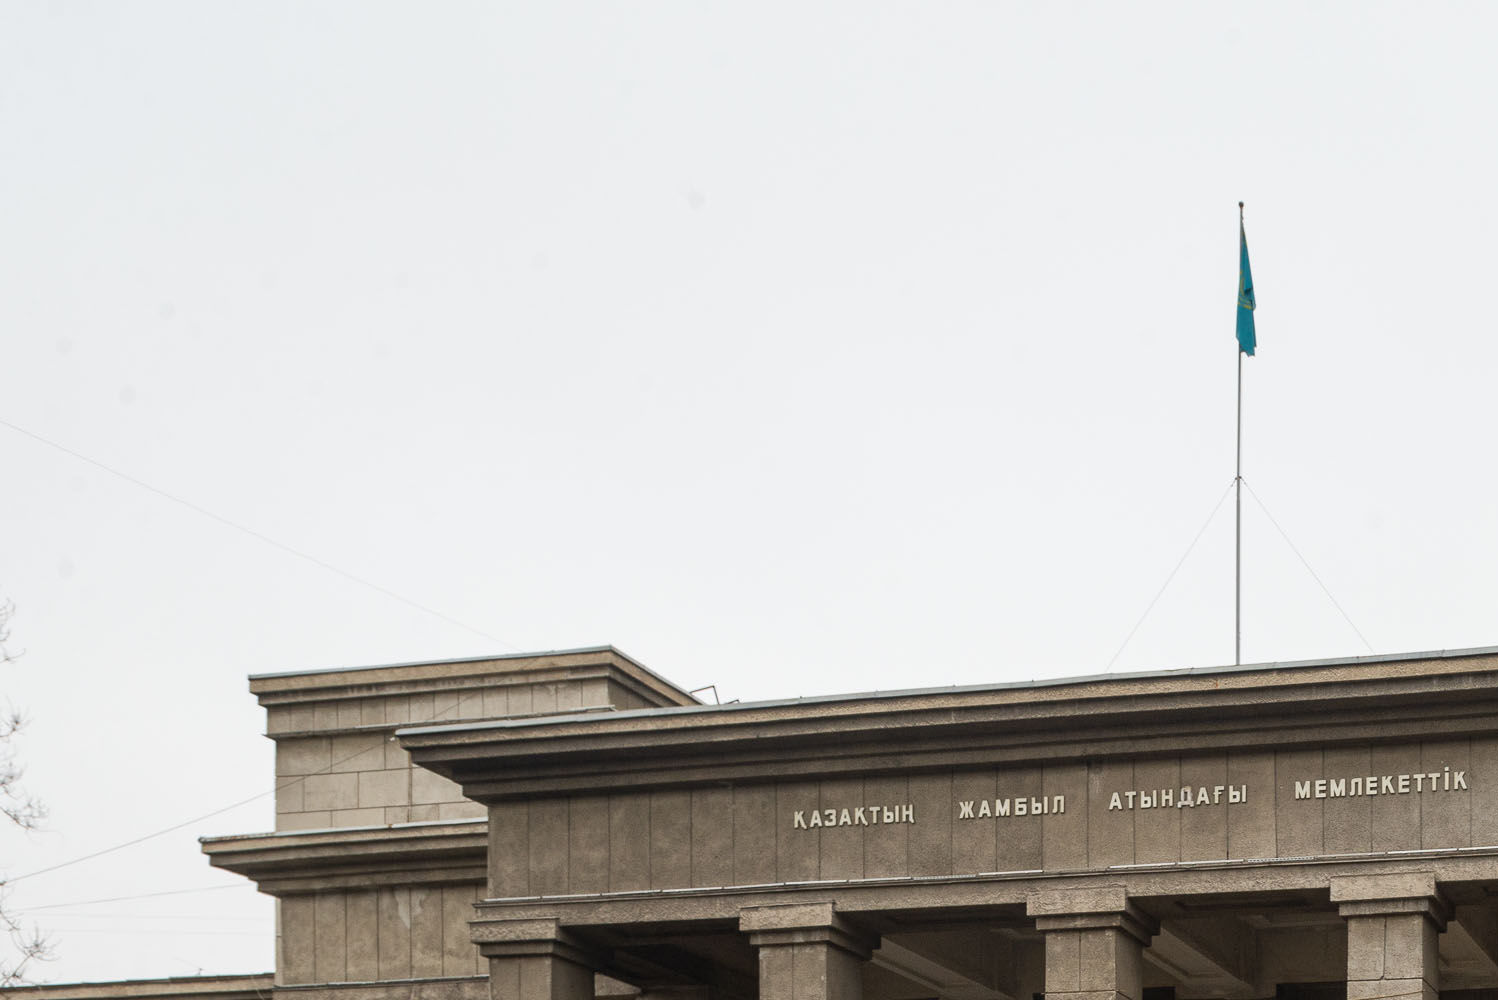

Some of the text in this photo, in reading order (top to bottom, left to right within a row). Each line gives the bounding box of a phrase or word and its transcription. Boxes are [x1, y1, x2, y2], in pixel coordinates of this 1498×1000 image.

[793, 804, 915, 830] ҚАЗАҚТЫҢ
[959, 795, 1065, 819] ЖАМБЫЛ
[1108, 784, 1247, 810] АТЫНДАҒЫ
[1295, 766, 1467, 799] МЕМЛЕКЕТТІК
